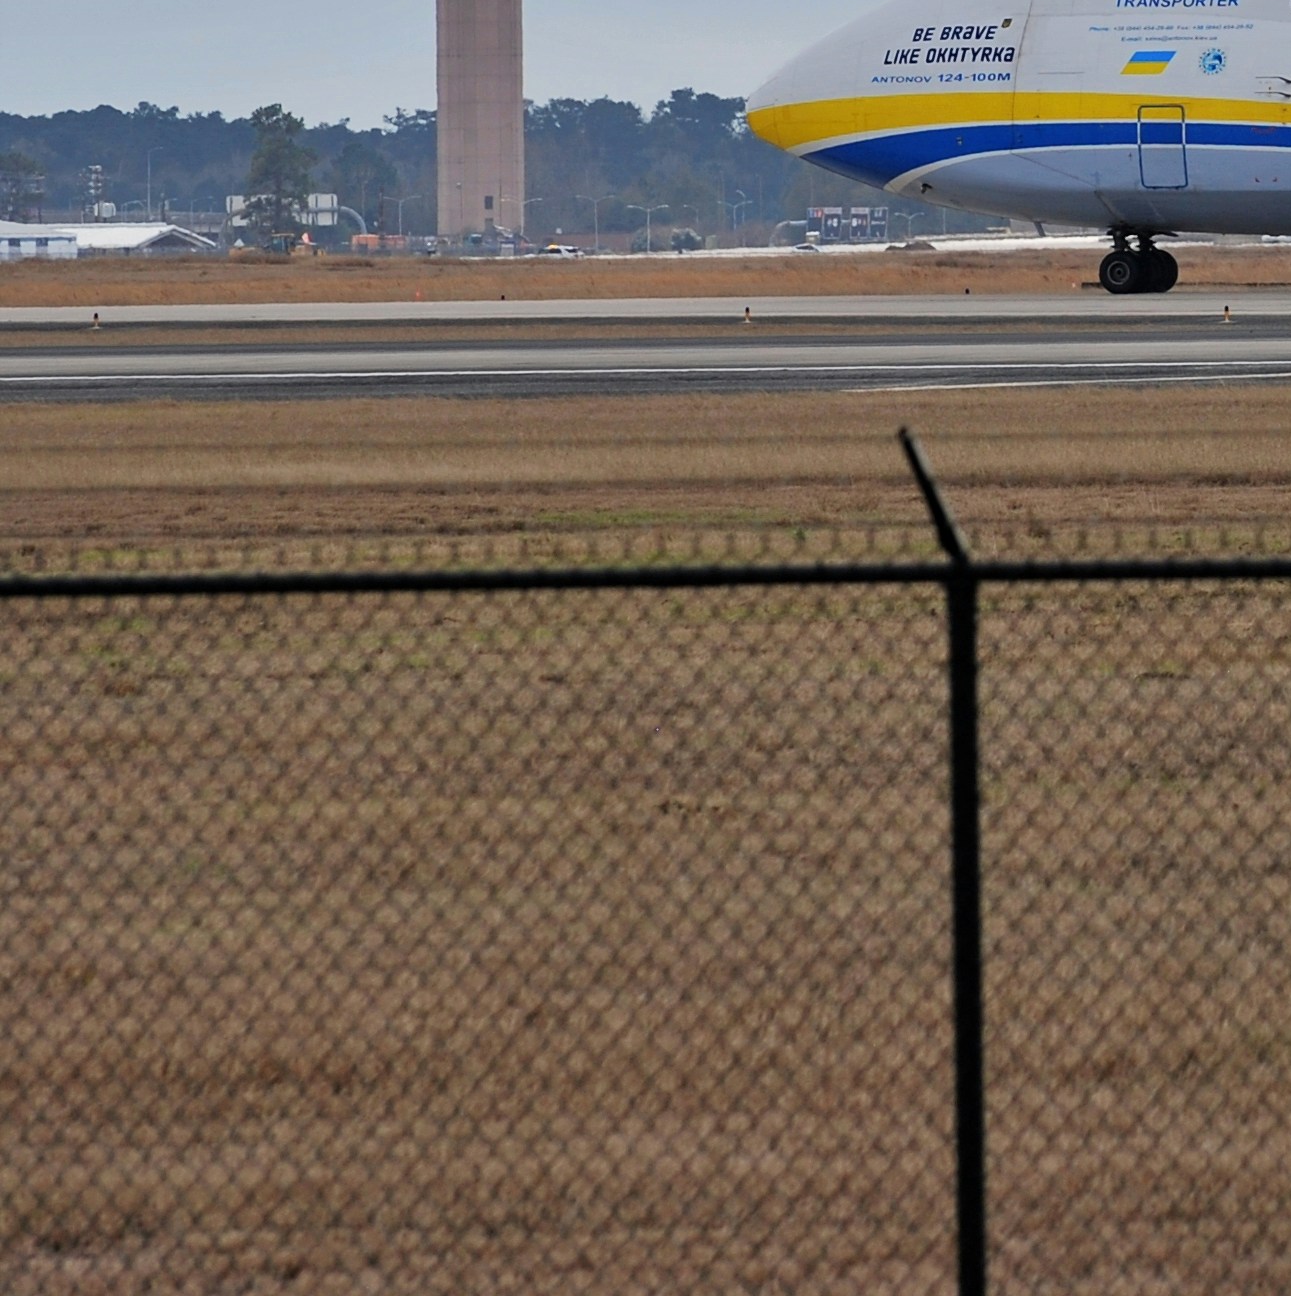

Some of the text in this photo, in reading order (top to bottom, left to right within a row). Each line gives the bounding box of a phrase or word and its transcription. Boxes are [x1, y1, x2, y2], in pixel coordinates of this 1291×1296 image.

[912, 27, 936, 42] BE
[884, 48, 921, 65] LIKE
[871, 72, 1011, 84] ANTONOV 124-100M
